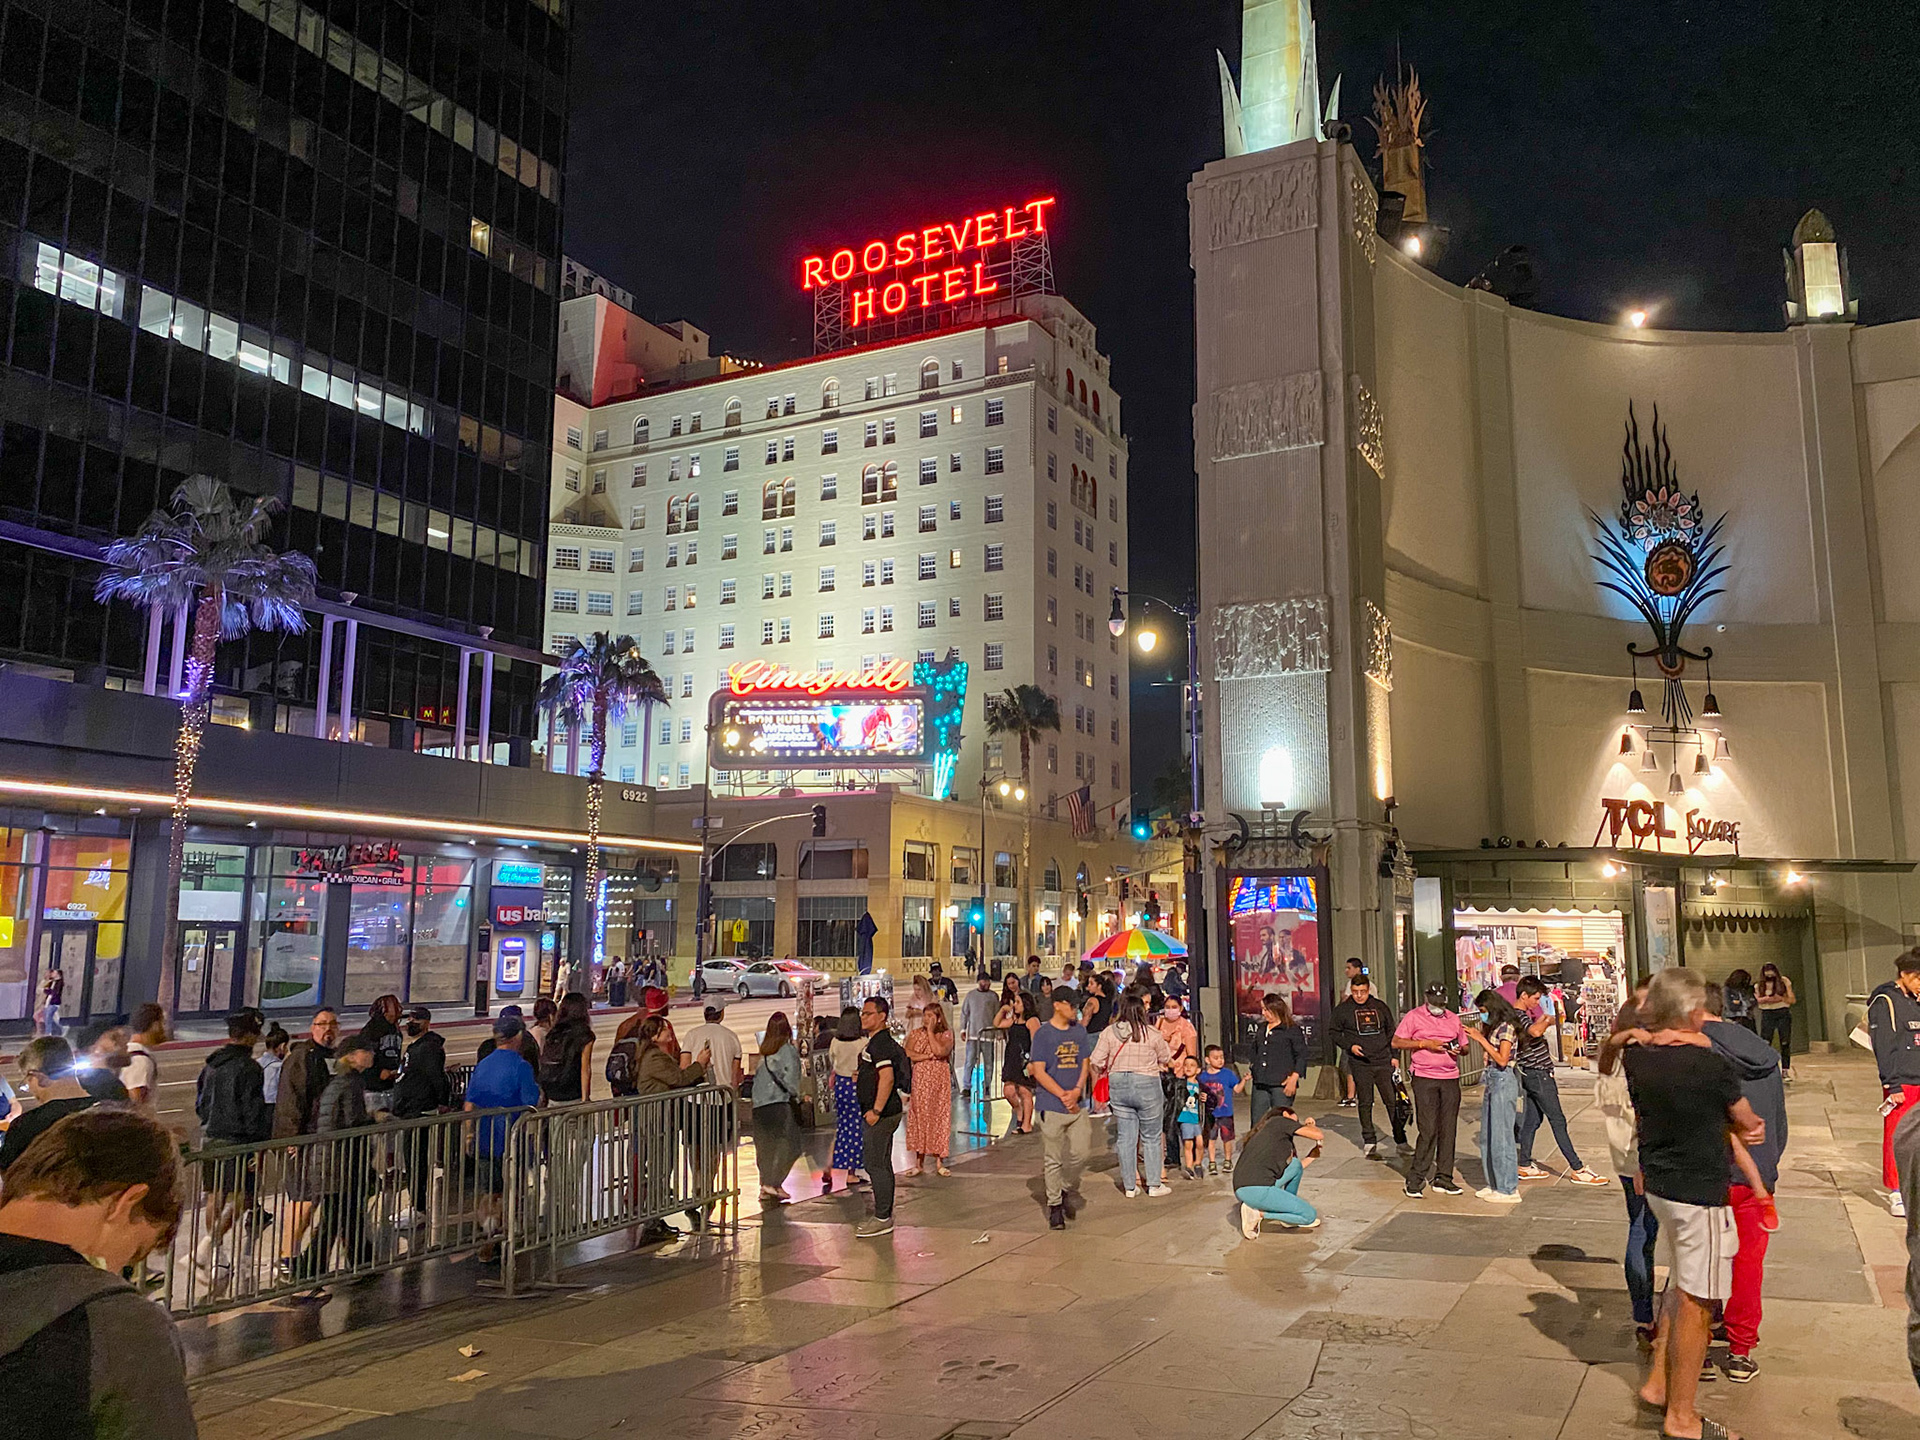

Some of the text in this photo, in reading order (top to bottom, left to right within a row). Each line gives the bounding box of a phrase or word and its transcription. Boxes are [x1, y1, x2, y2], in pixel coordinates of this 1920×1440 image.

[803, 197, 1055, 289] ROOSEVELT
[852, 262, 998, 327] HOTEL
[728, 658, 909, 695] Cinegrill
[623, 789, 648, 802] 6922
[1602, 798, 1676, 838] TCL
[348, 841, 401, 865] FRESH
[343, 875, 403, 885] MEXICAN GRILL
[596, 878, 607, 909] Bean
[595, 910, 605, 942] Coffee
[1244, 971, 1311, 987] IMAX
